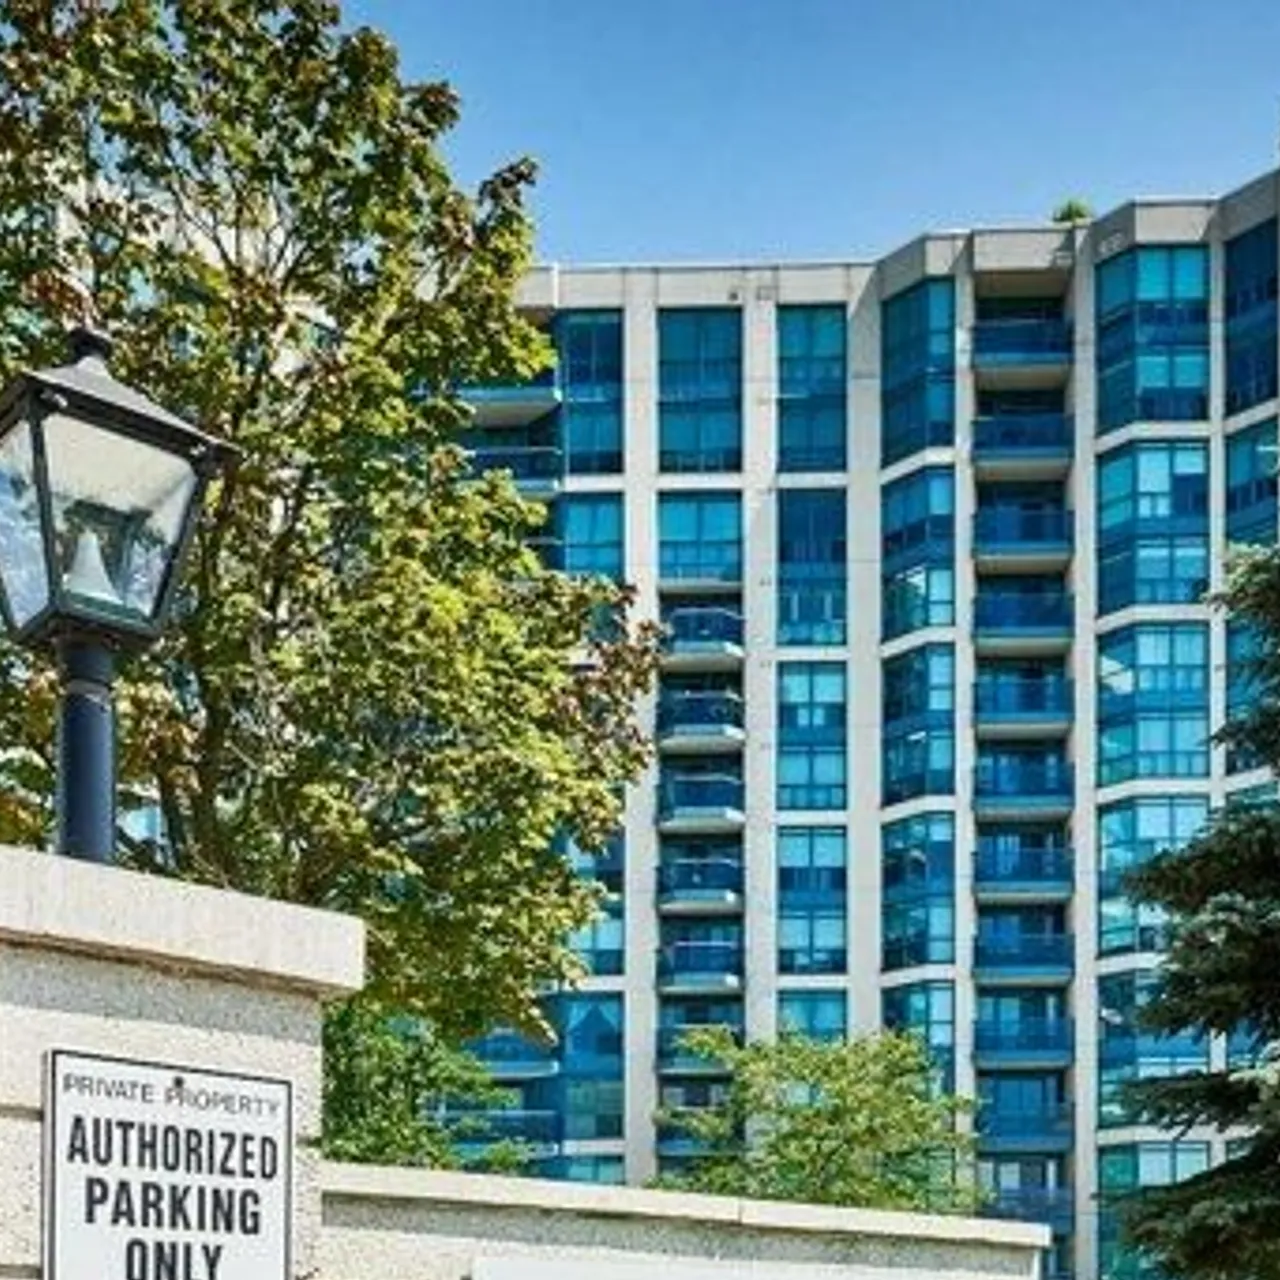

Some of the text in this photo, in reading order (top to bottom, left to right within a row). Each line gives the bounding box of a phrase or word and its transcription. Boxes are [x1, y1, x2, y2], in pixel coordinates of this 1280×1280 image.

[63, 1073, 279, 1117] PRIVATE PROPERTY
[66, 1115, 278, 1180] AUTHORIZED
[85, 1177, 261, 1235] PARKING
